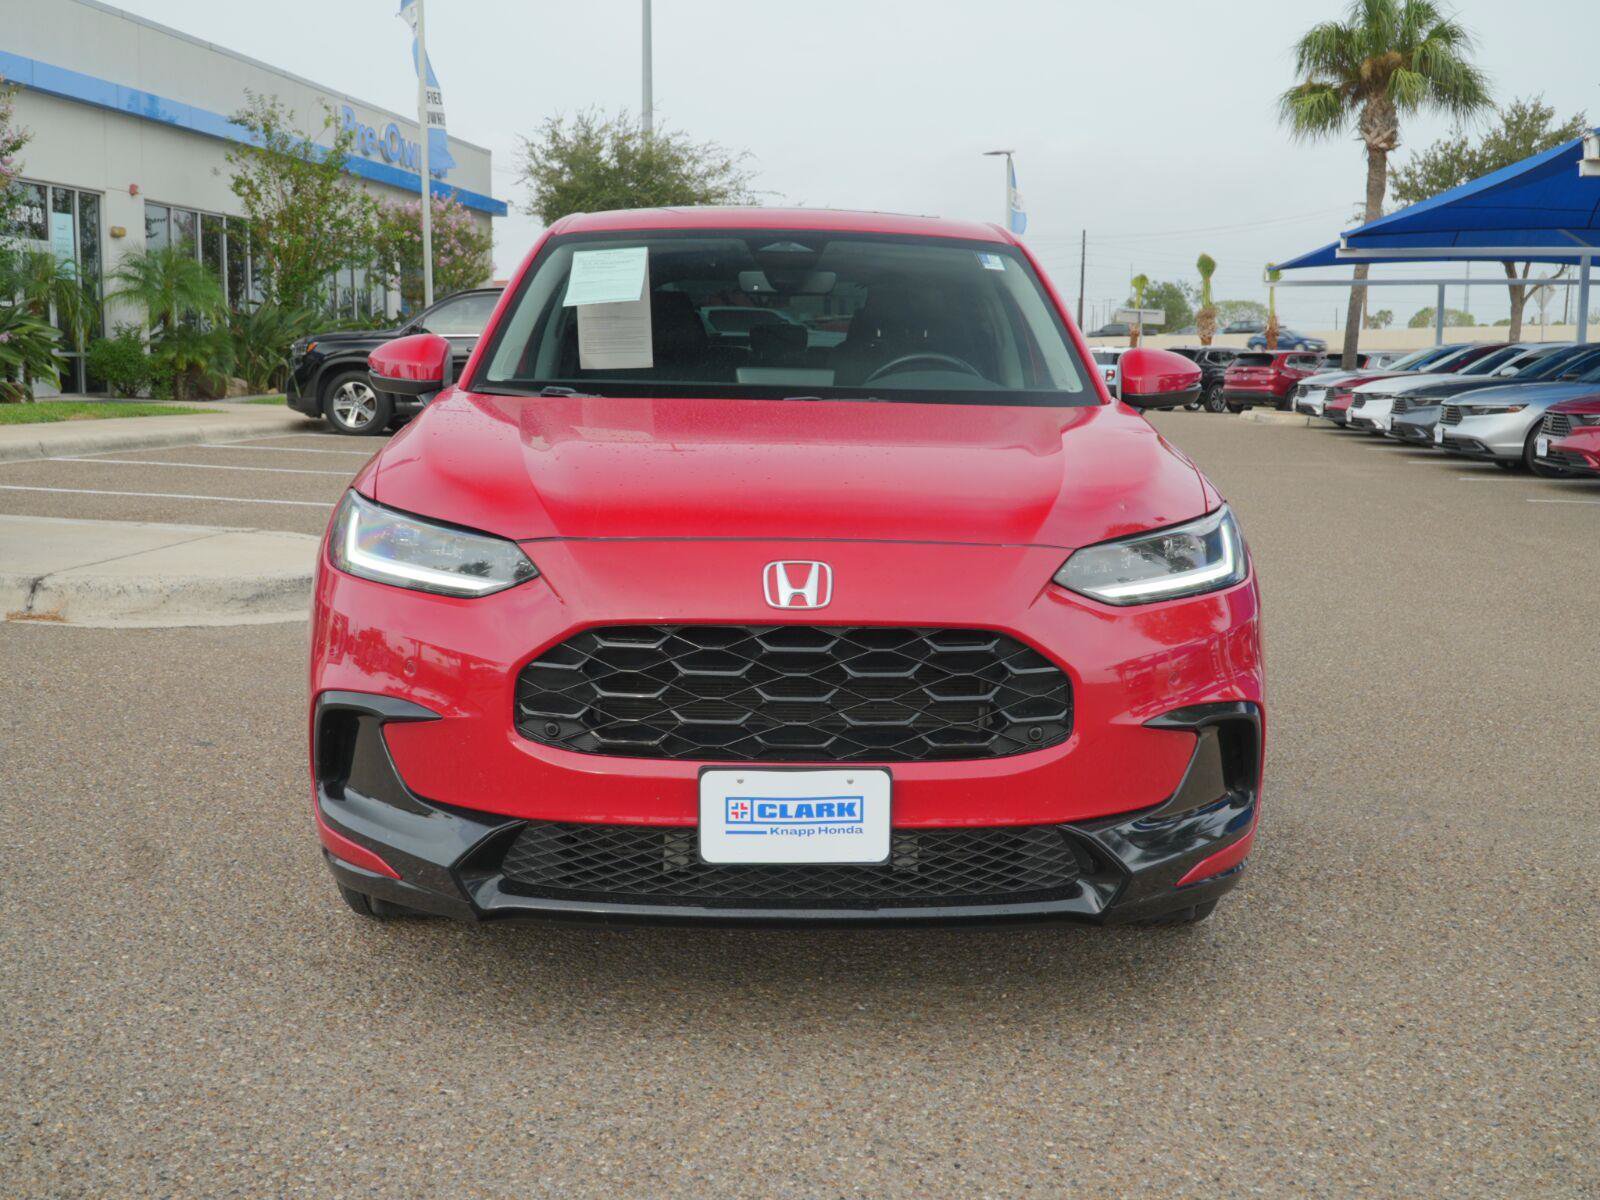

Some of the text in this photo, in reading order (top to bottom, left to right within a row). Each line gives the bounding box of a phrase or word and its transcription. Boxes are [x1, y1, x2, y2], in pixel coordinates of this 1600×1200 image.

[757, 802, 857, 819] CLARK
[769, 826, 864, 837] Knapp Honda
